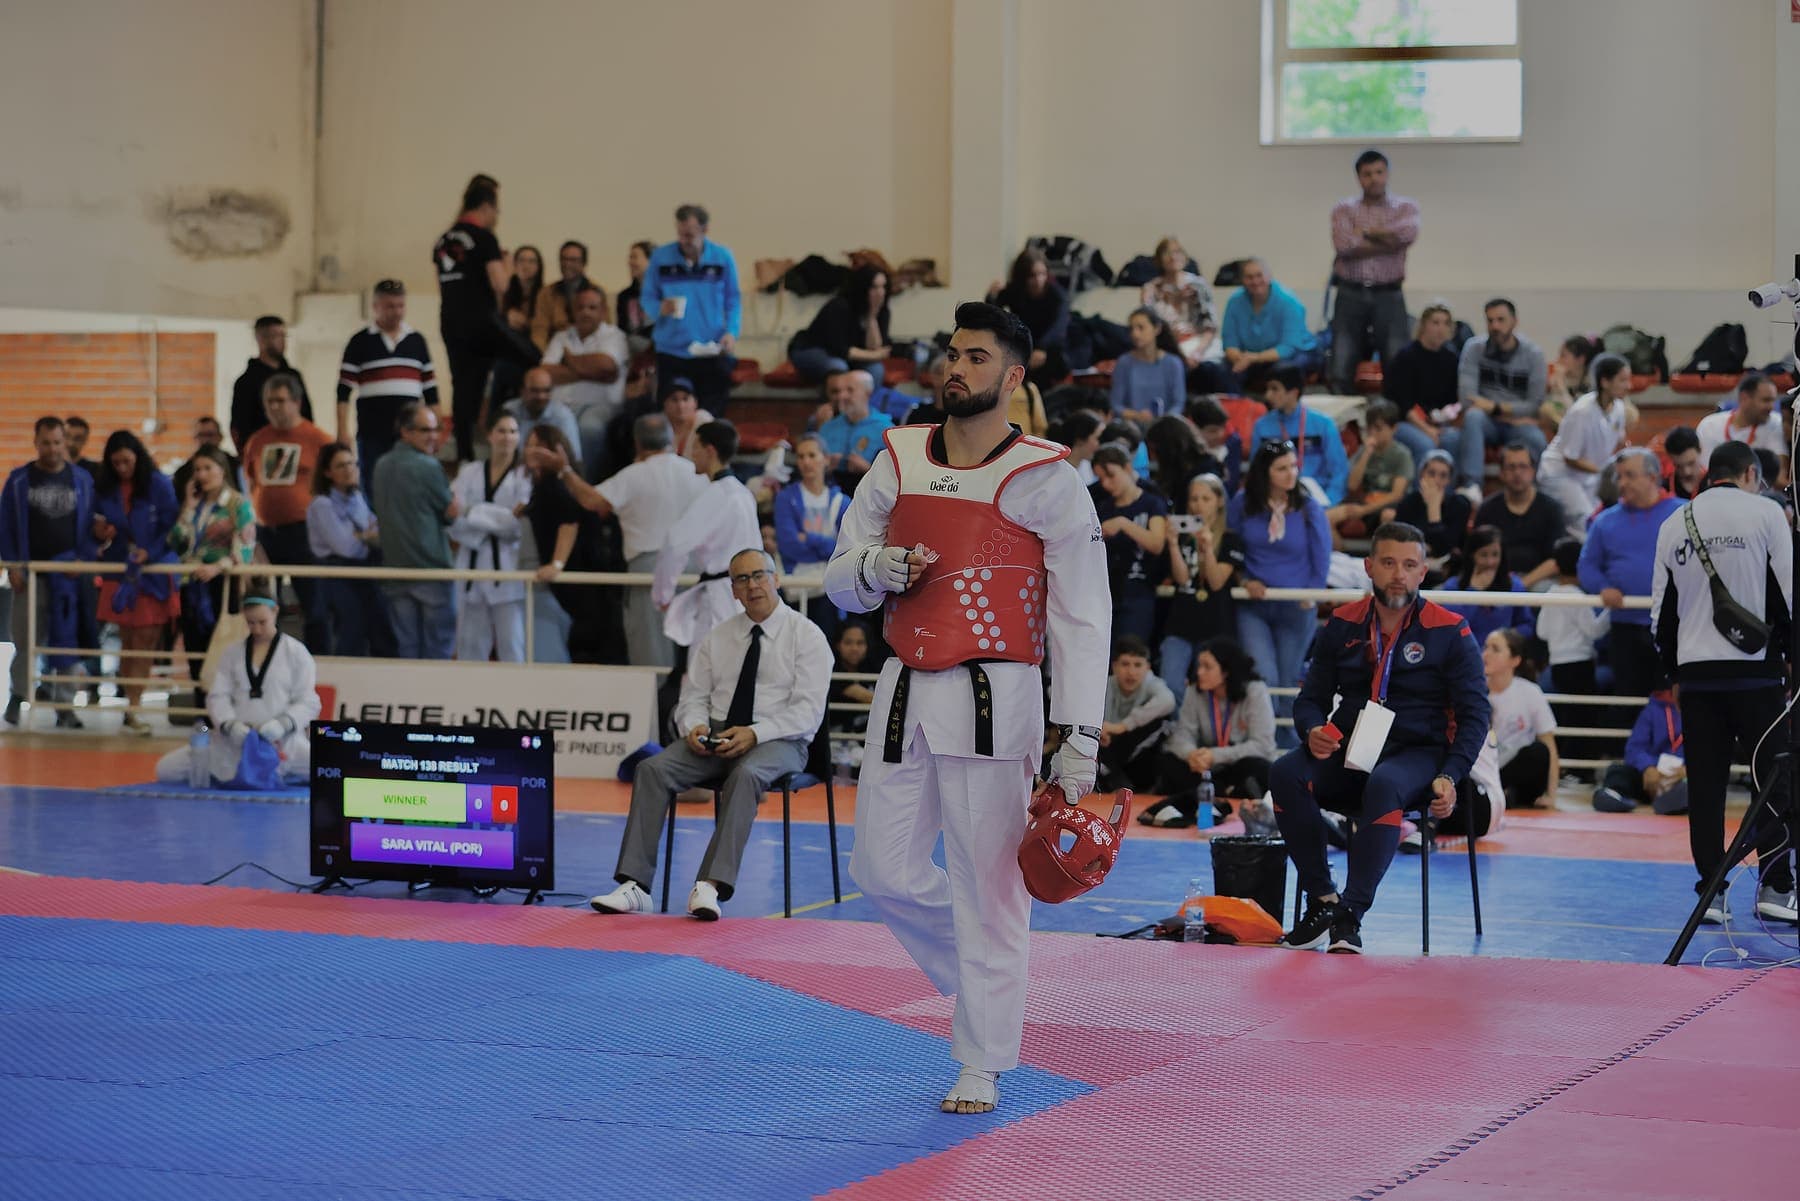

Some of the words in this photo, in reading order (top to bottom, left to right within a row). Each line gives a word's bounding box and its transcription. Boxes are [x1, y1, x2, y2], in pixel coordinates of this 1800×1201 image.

[915, 646, 924, 660] 4
[339, 703, 444, 725] LEITE
[462, 708, 631, 732] JANEIRO
[570, 740, 626, 756] PNEUS
[316, 766, 342, 778] POR
[381, 758, 419, 771] MATCH
[438, 760, 480, 774] RESULT
[521, 777, 547, 789] POR
[383, 794, 427, 806] WINNER
[474, 798, 483, 810] 0
[500, 799, 509, 812] 0
[381, 837, 413, 851] SARA
[415, 839, 448, 853] VITAL
[450, 841, 482, 857] (POR)
